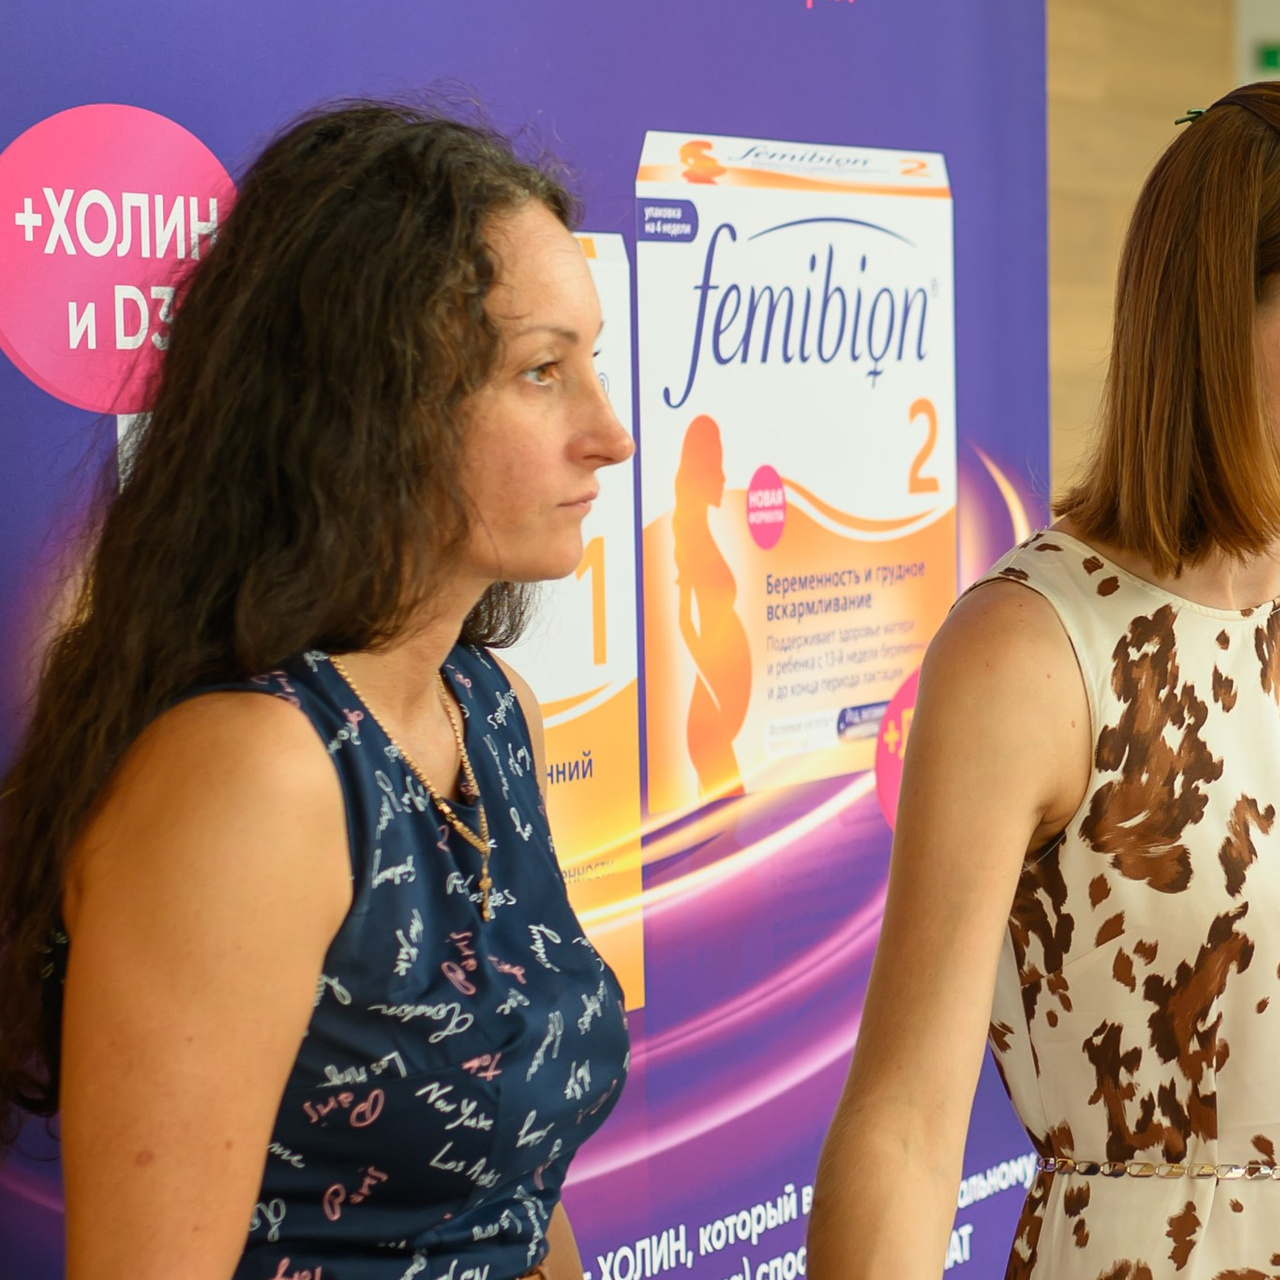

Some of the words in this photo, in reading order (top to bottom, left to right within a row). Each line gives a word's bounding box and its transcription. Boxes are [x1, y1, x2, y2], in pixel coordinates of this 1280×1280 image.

[728, 145, 872, 167] femibion
[899, 159, 930, 177] 2
[644, 206, 683, 221] упаковка
[645, 221, 656, 235] на
[656, 220, 662, 234] 4
[662, 221, 692, 237] недели
[68, 302, 97, 350] и
[114, 285, 176, 351] D3
[663, 223, 928, 409] femibion
[908, 397, 940, 495] 2
[748, 488, 784, 509] НОВАЯ
[766, 569, 861, 599] Беременность
[864, 567, 872, 582] и
[876, 561, 926, 587] грудное
[575, 536, 607, 666] 1
[766, 592, 873, 624] вскармливание
[699, 1183, 797, 1257] который
